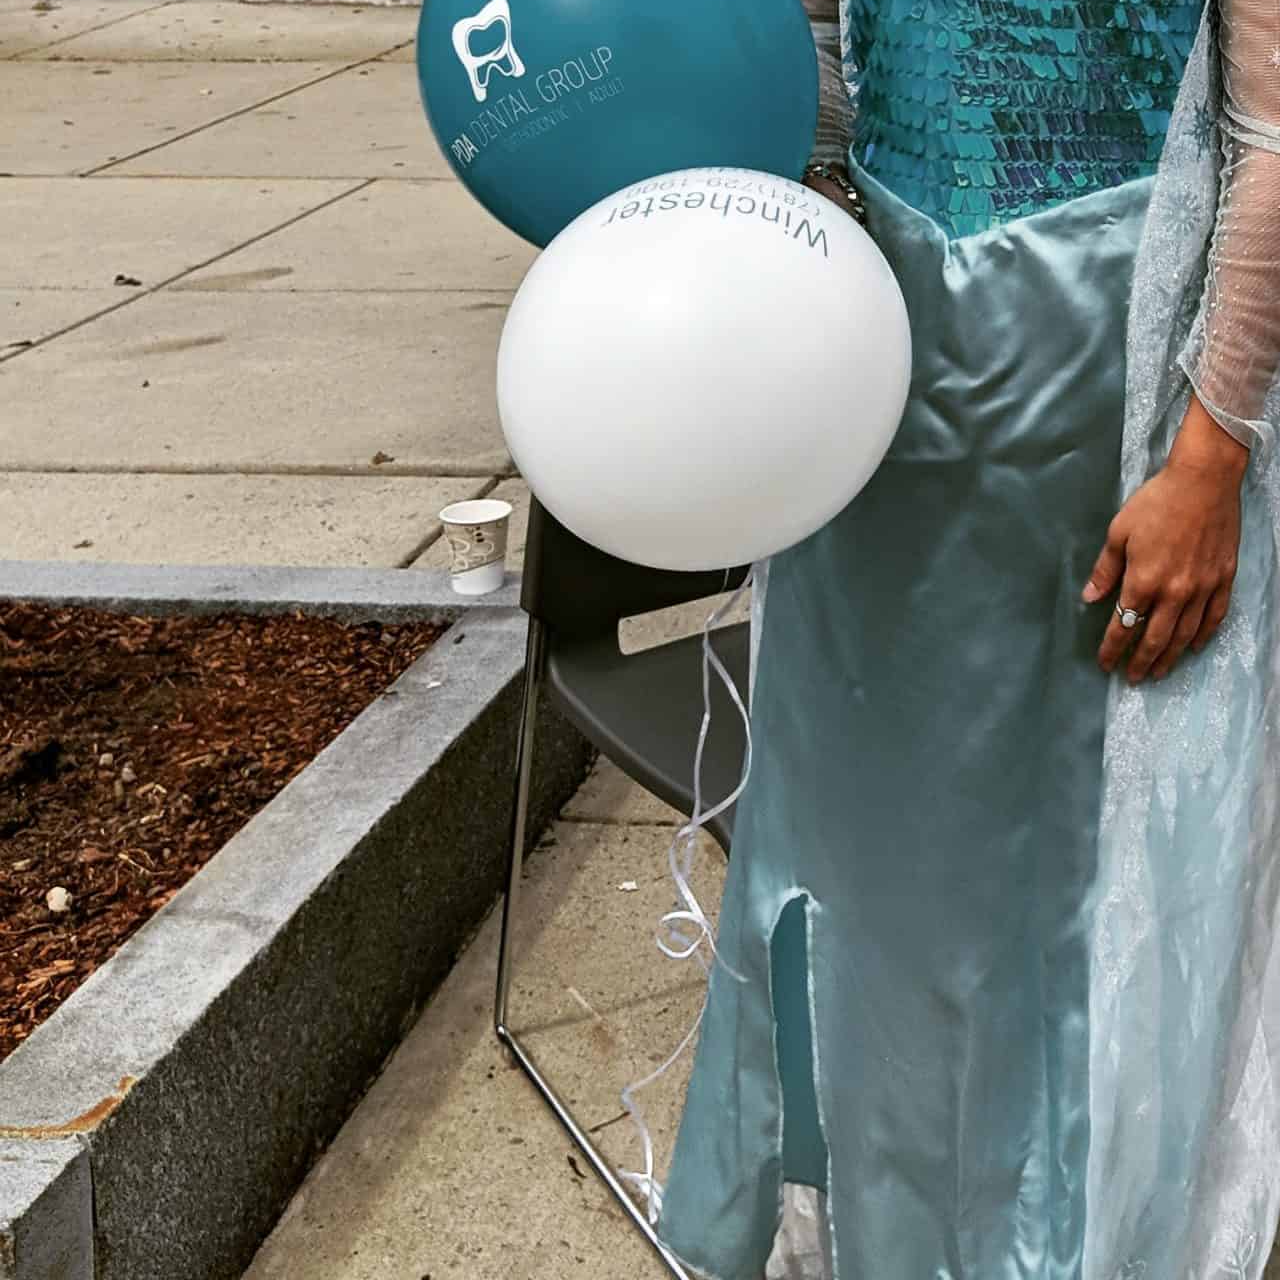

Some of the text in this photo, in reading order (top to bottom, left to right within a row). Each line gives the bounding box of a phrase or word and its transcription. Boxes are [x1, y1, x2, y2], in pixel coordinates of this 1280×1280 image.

[451, 46, 613, 168] PDA DENTAL GROUP
[600, 191, 828, 257] Winchester
